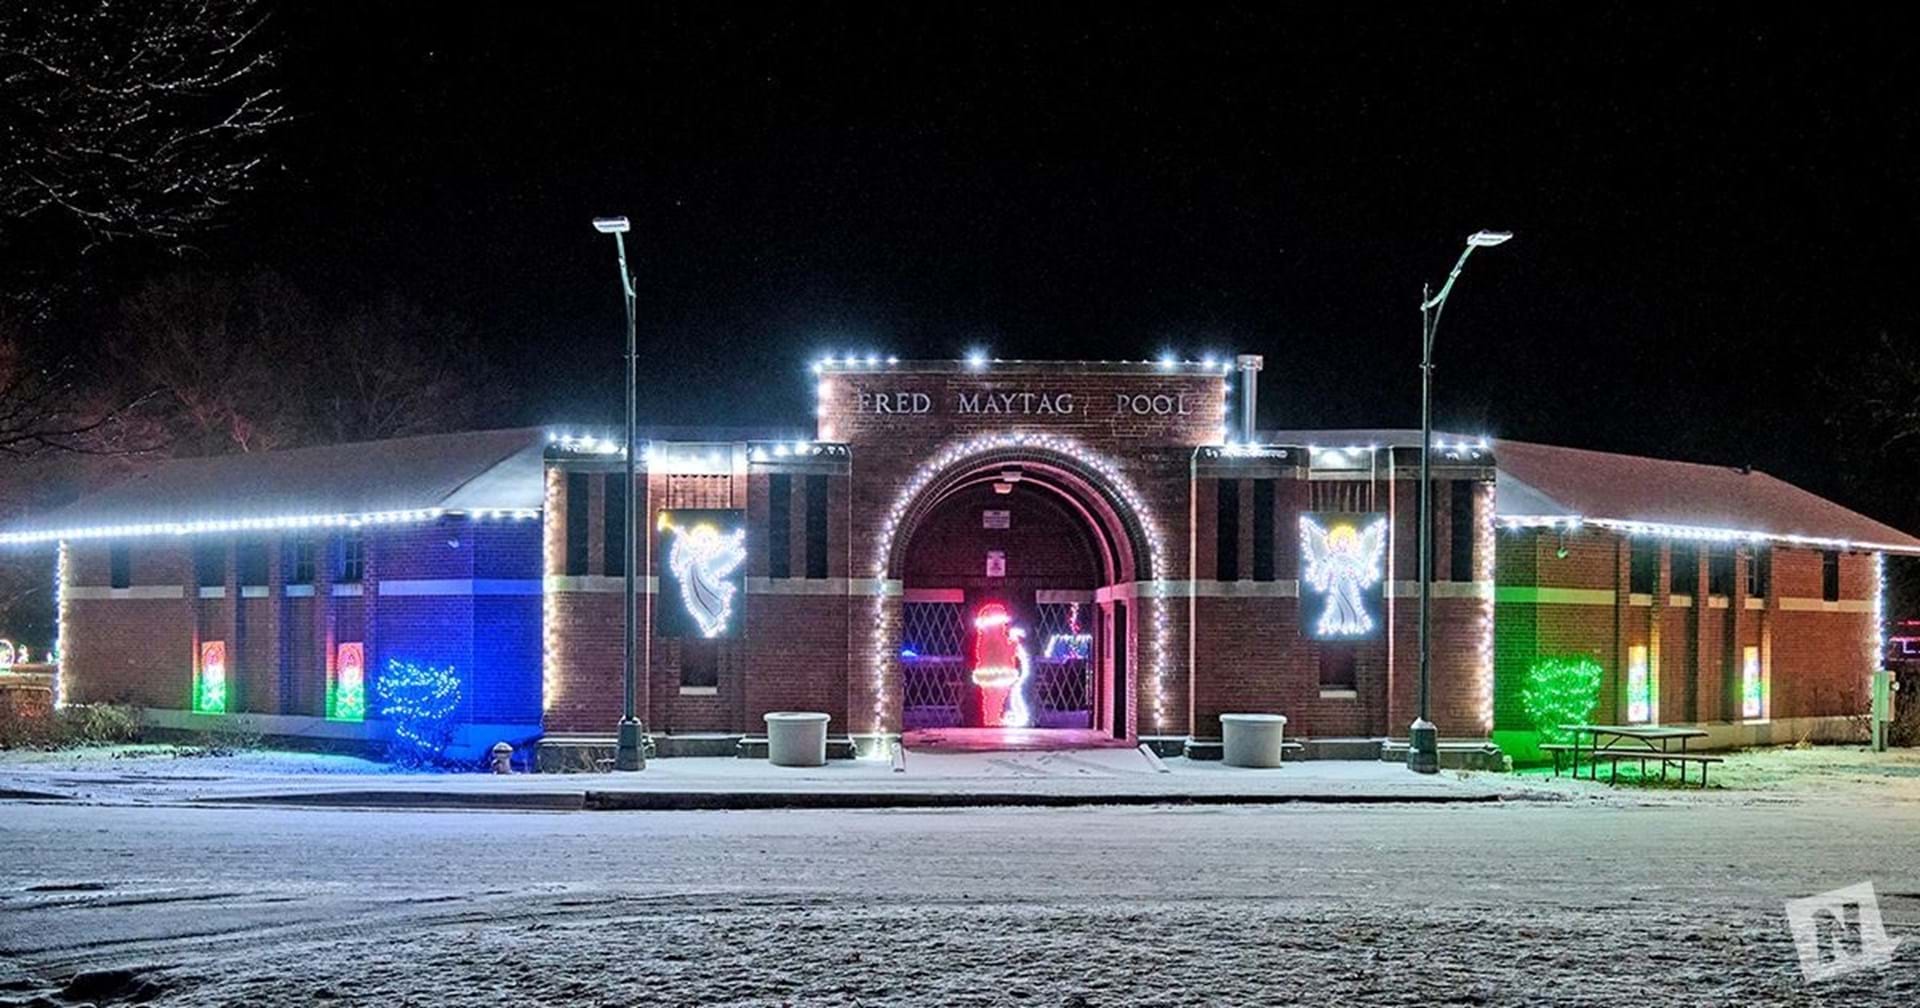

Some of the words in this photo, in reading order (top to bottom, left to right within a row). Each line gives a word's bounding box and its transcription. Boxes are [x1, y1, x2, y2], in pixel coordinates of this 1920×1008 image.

[857, 393, 932, 415] FRED
[958, 393, 1074, 415] MAYTAG
[1116, 393, 1193, 416] POOL
